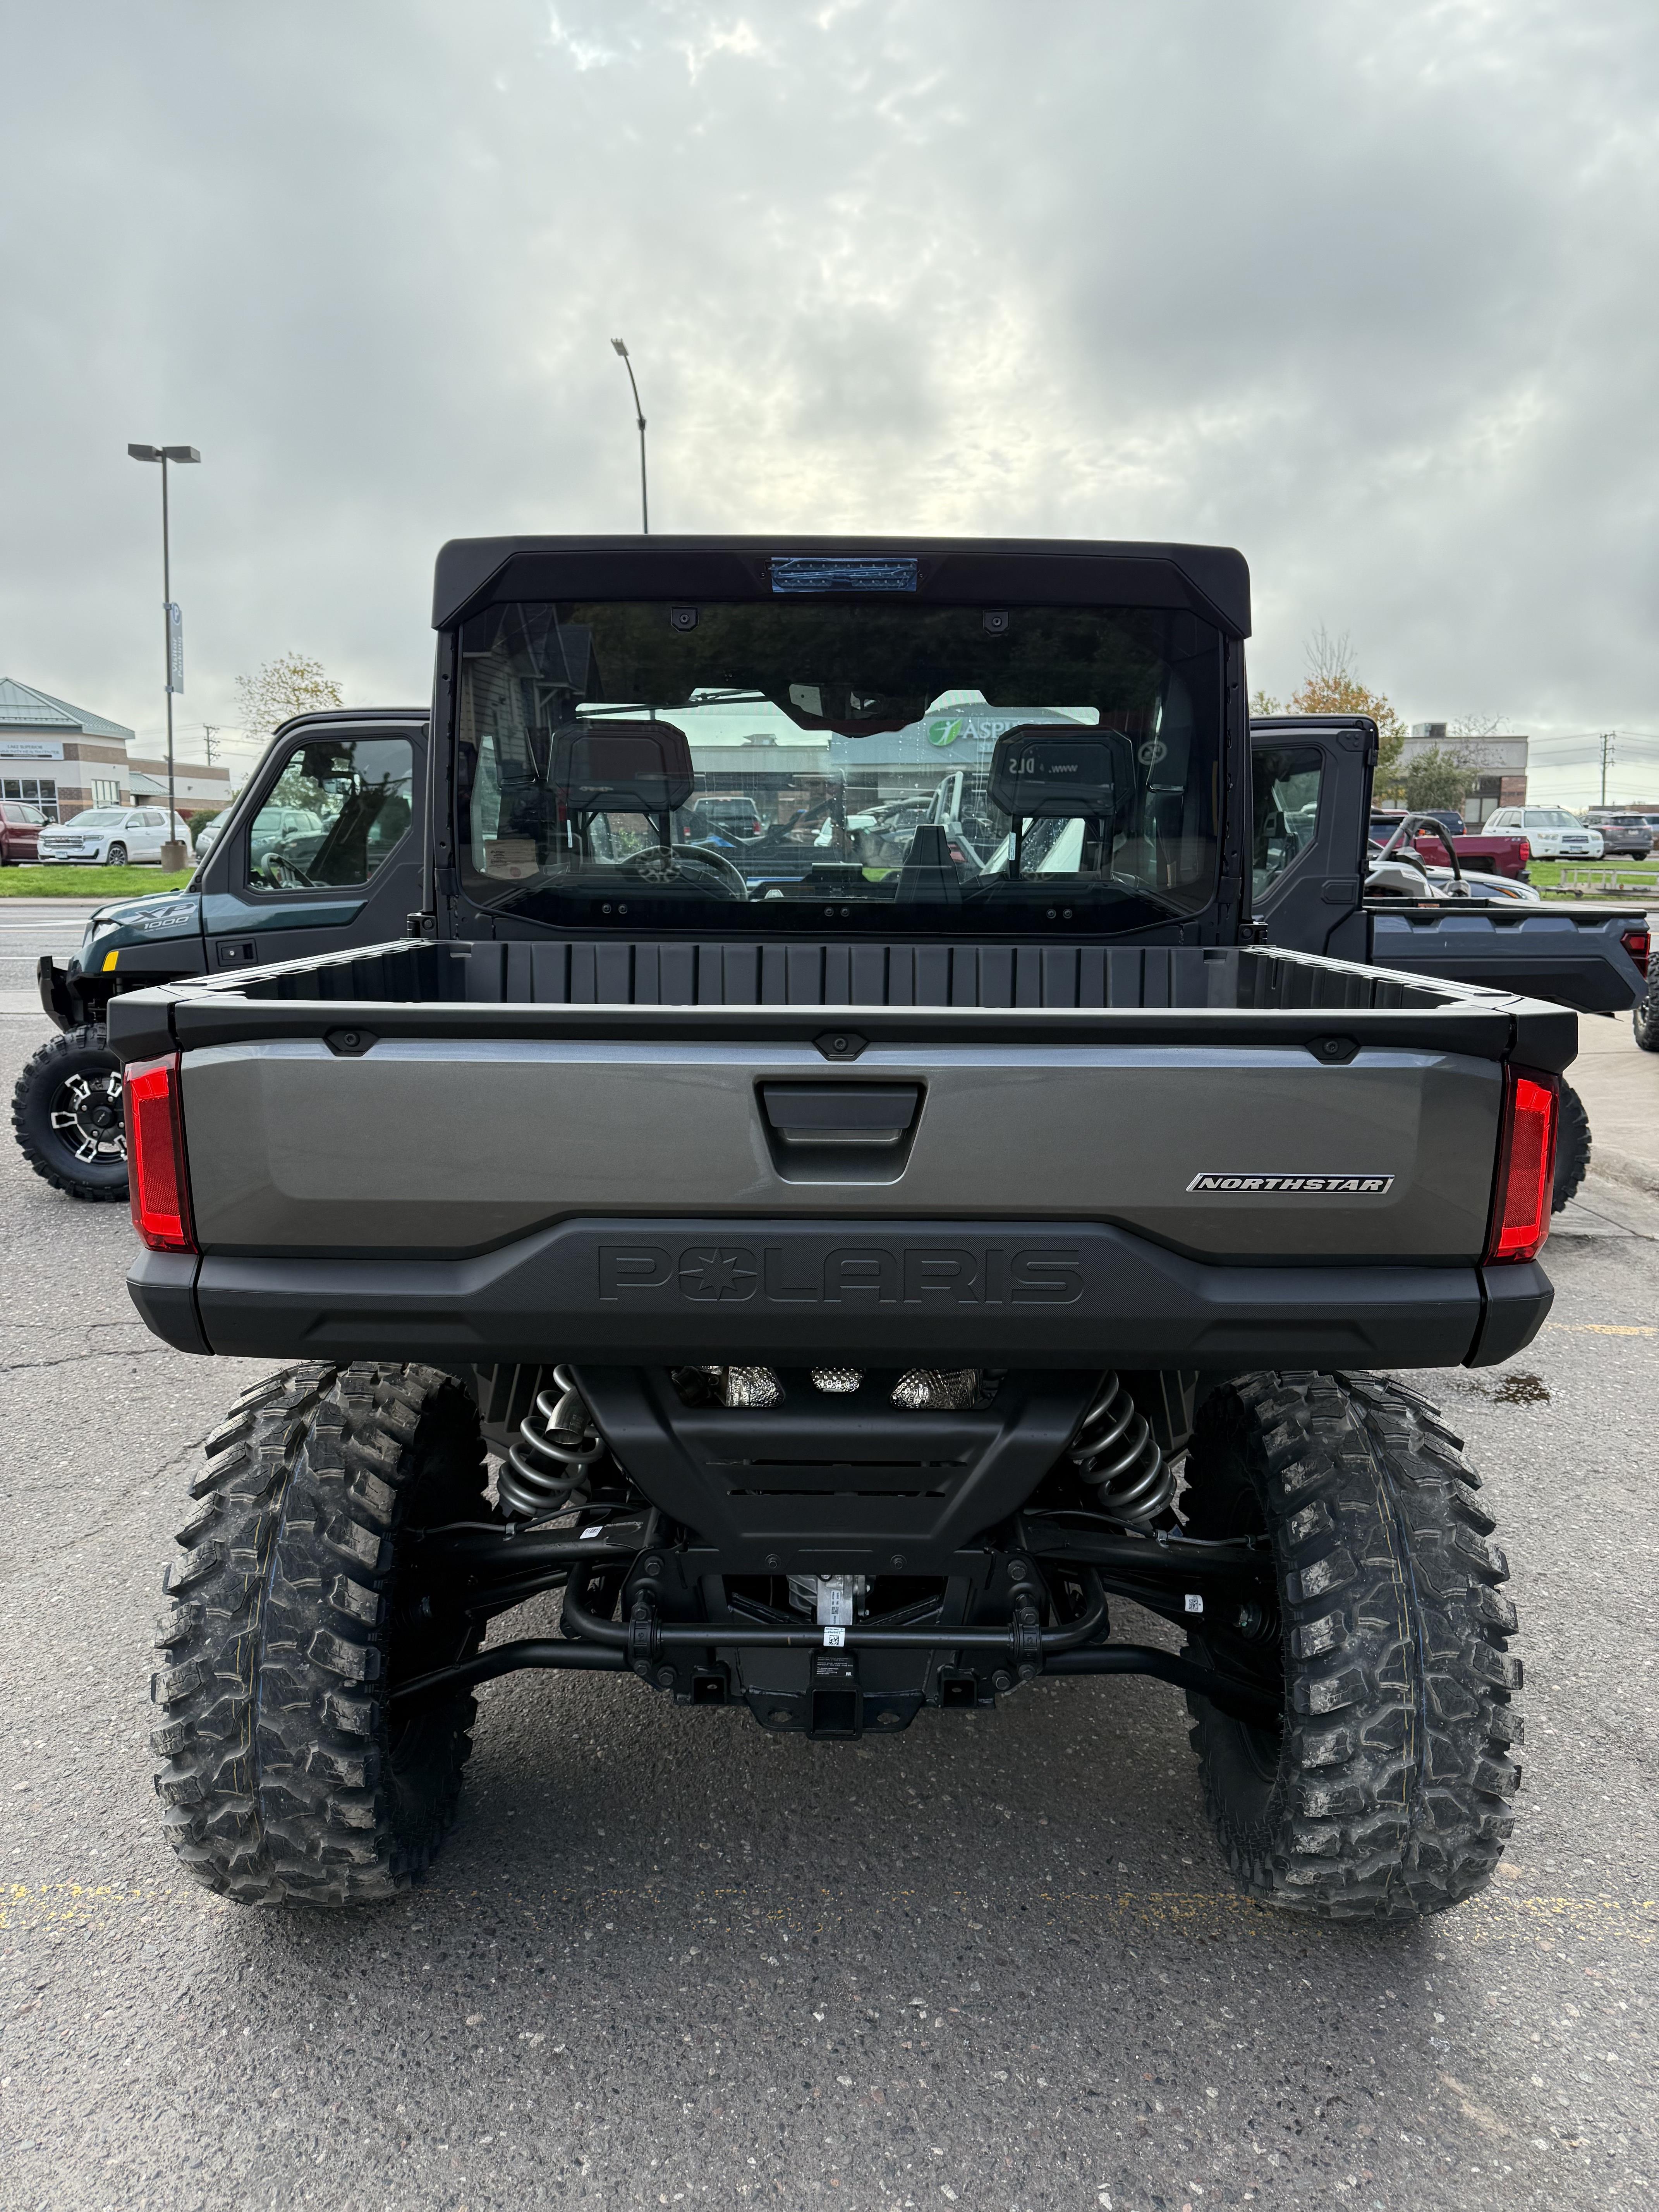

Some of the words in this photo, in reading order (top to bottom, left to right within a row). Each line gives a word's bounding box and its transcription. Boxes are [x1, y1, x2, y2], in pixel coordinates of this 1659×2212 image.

[174, 605, 179, 620] P
[129, 903, 194, 923] XP
[144, 916, 189, 929] 1000
[1198, 1178, 1384, 1191] NORTHSTAR
[598, 1246, 1084, 1305] POLARIS
